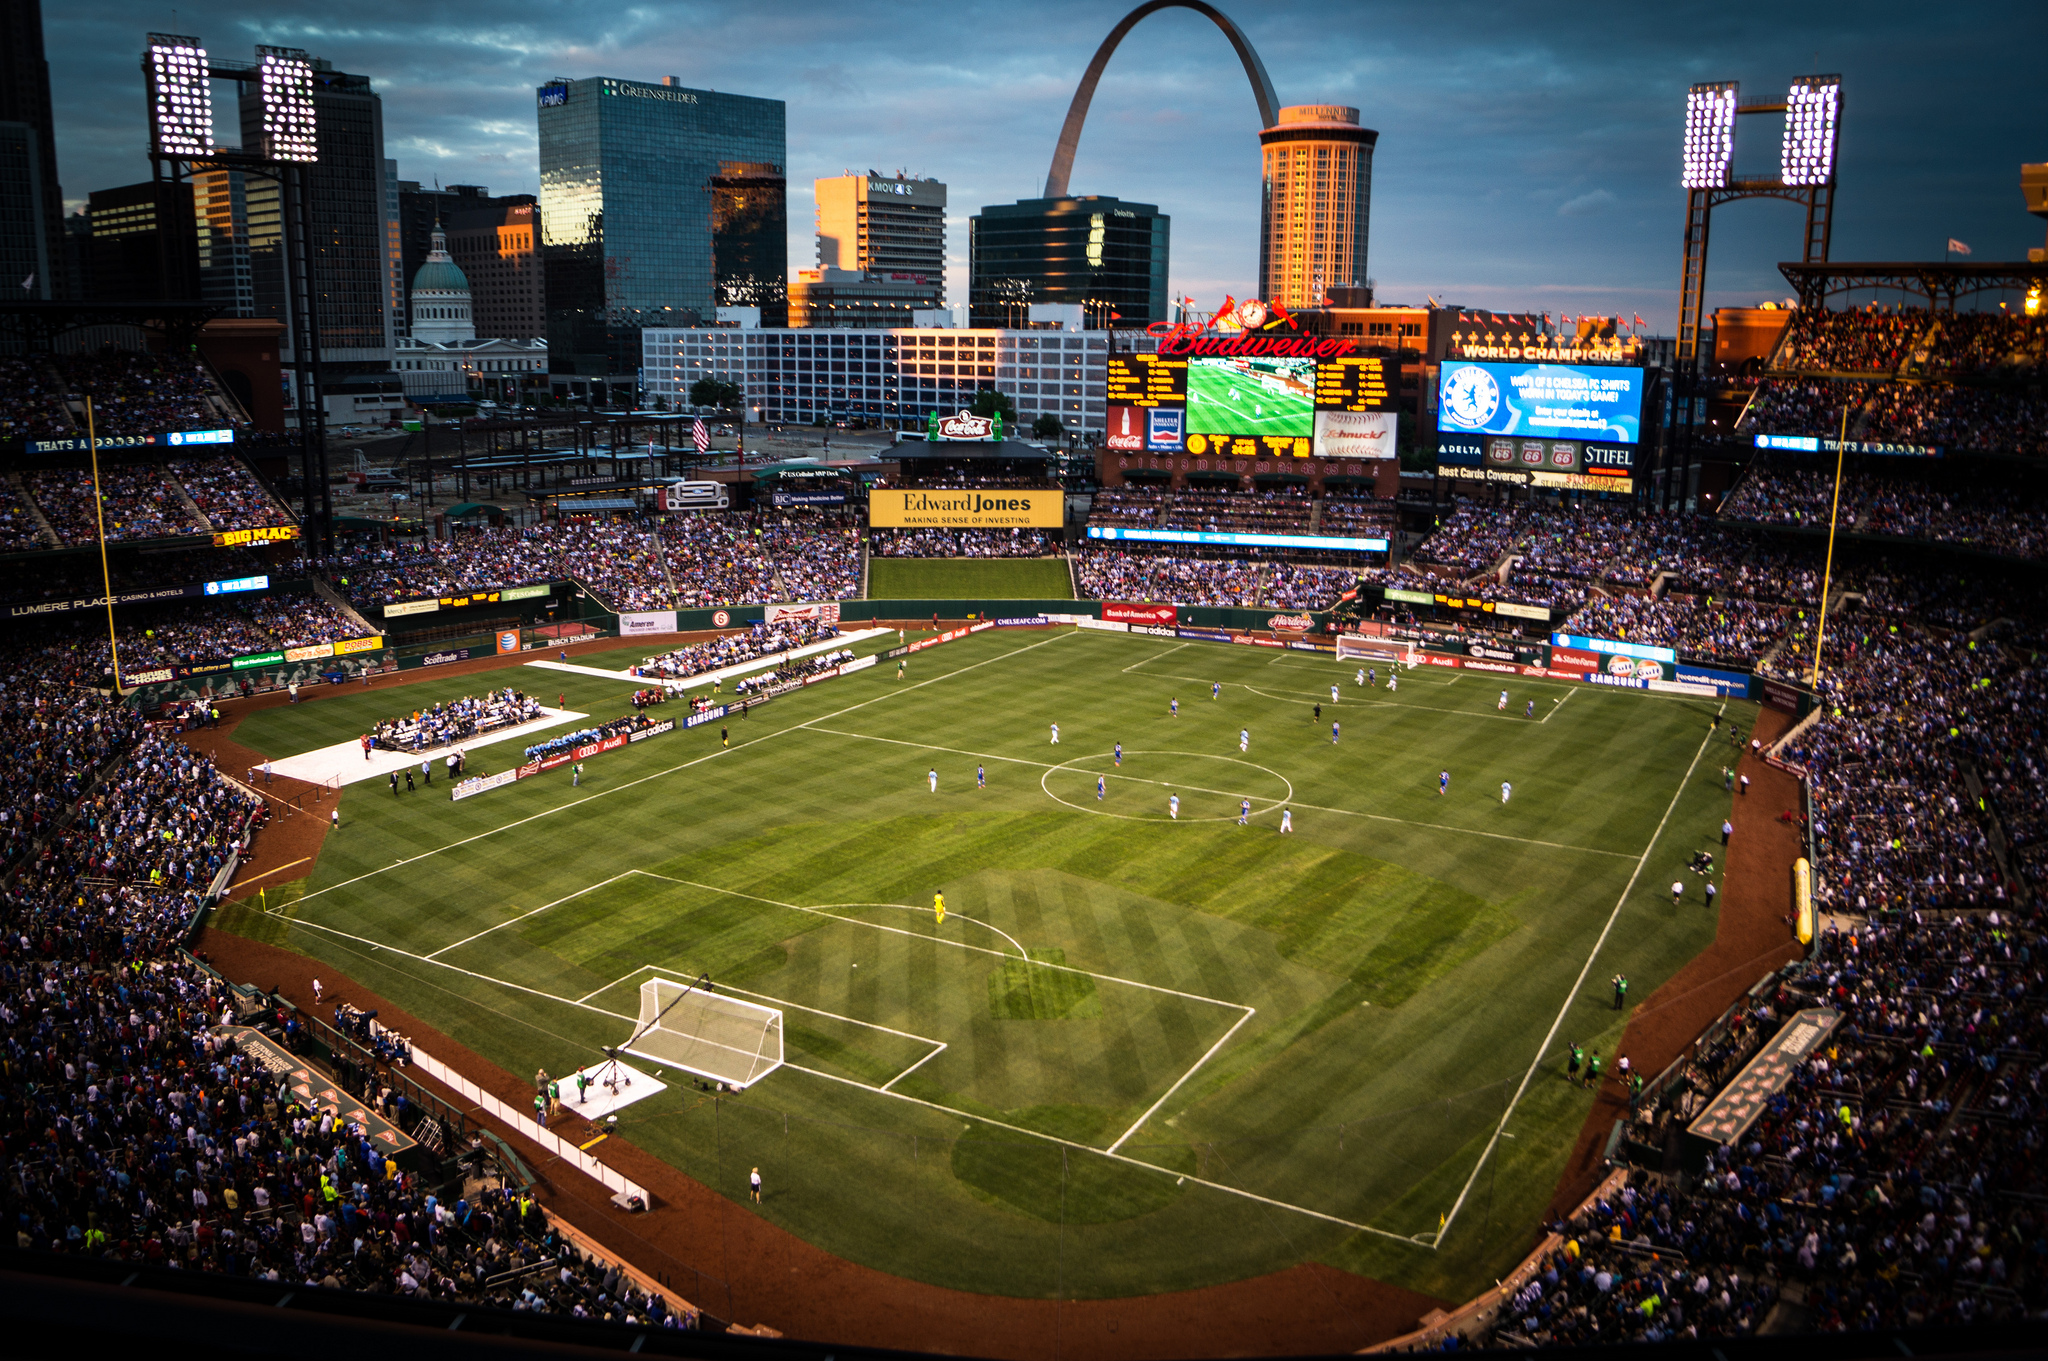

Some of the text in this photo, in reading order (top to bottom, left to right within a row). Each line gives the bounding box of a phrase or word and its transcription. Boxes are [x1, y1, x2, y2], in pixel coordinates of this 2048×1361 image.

[540, 93, 565, 108] KPMG
[868, 183, 893, 193] KMOV
[1147, 321, 1358, 358] Budweiser
[1463, 345, 1623, 362] WORLD CHAMPIONS
[1553, 378, 1588, 389] CHELSEA
[1601, 380, 1630, 391] SHIRTS
[945, 420, 986, 435] Coca-Cola
[1323, 429, 1387, 439] Schnucks
[36, 439, 74, 452] THAT'S
[79, 439, 88, 450] A
[1108, 435, 1142, 448] Coca-Cola
[1823, 440, 1857, 452] THAT'S
[1861, 442, 1869, 453] A
[1449, 445, 1481, 456] DELTA
[1494, 449, 1509, 459] 66
[1525, 451, 1539, 461] 66
[1555, 453, 1570, 463] 66
[1585, 446, 1633, 466] STIFEL
[1197, 460, 1207, 470] 10
[1216, 460, 1227, 471] 14
[1236, 461, 1247, 471] 17
[1255, 462, 1269, 471] 20
[1278, 462, 1292, 472] 24
[1301, 463, 1316, 473] 42
[1324, 464, 1339, 474] 45
[1347, 464, 1362, 475] 85
[1439, 466, 1527, 484] Best Cards Coverage
[775, 495, 788, 503] BJC
[903, 494, 1031, 513] Edward Jones
[224, 527, 292, 546] BIG MAC
[246, 539, 270, 548] LAND
[11, 601, 70, 616] LUMIÈRE
[73, 596, 118, 610] PLACE
[121, 594, 148, 602] CASINO
[156, 589, 183, 598] HOTELS
[1107, 609, 1122, 617] Bank
[1129, 611, 1155, 619] America
[630, 620, 655, 629] Ameren
[997, 617, 1046, 626] CHELSEAFC.COM
[955, 630, 966, 638] Audi
[1148, 627, 1175, 637] adidas
[344, 639, 373, 648] DOBBS
[548, 634, 595, 646] BUSCH STADIUM
[424, 653, 457, 666] Scottrade
[1485, 649, 1514, 660] MIDWEST
[1432, 657, 1453, 666] Audi
[1609, 663, 1633, 673] Gulf
[1637, 666, 1660, 676] Gulf
[135, 675, 173, 685] HOMES
[1591, 674, 1642, 688] SAMSUNG
[687, 706, 724, 727] SAMSUNG
[647, 720, 673, 737] adidas
[603, 736, 622, 749] Audi
